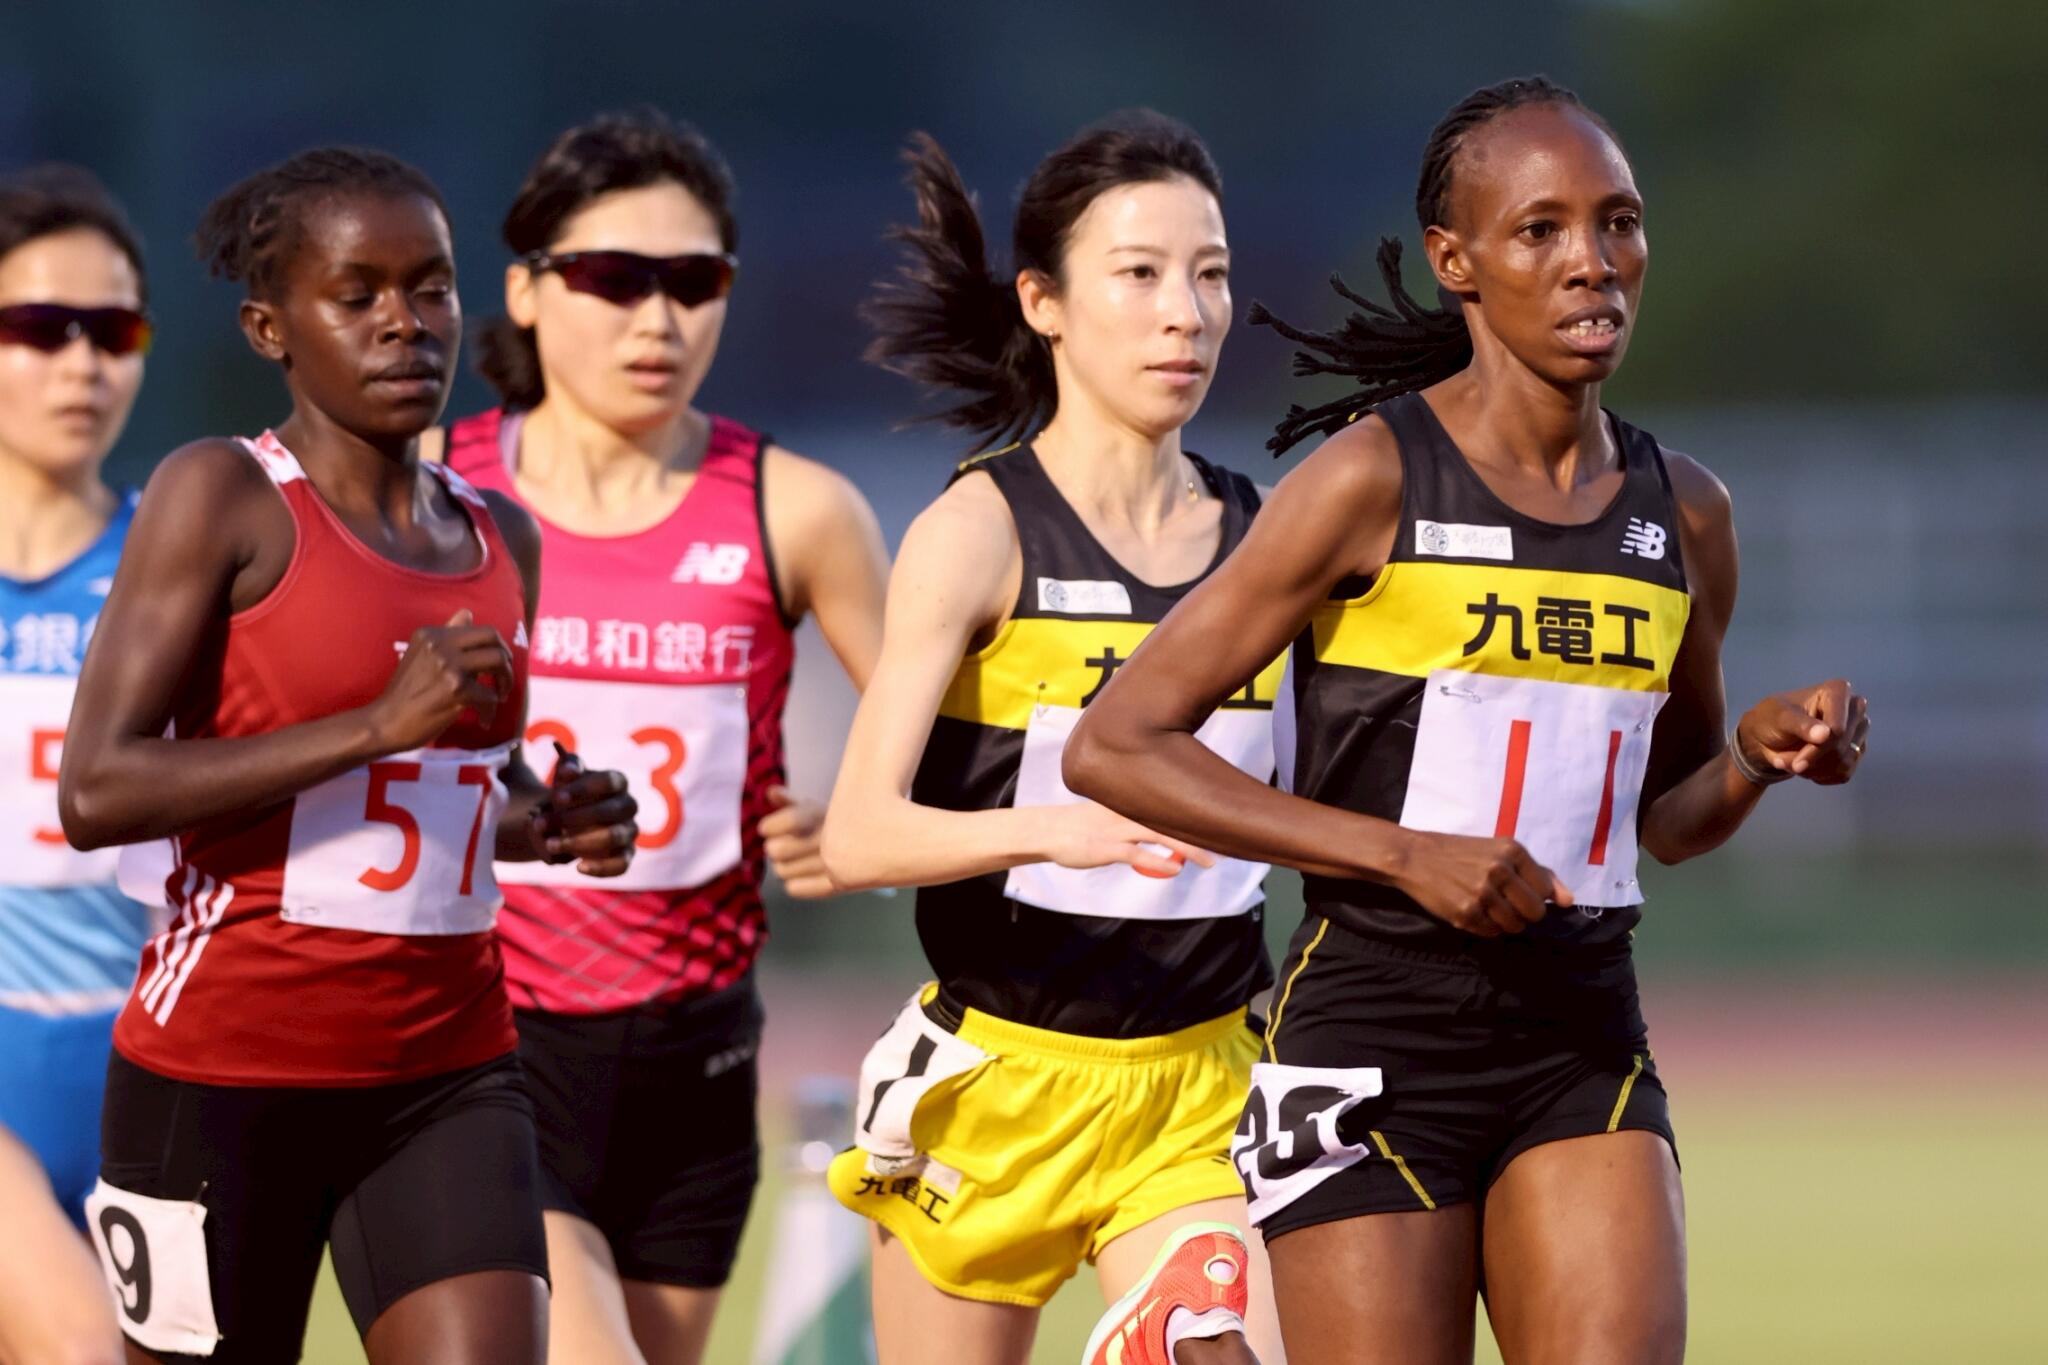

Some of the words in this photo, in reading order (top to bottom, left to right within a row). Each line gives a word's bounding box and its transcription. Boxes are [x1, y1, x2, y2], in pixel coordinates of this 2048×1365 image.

[671, 542, 750, 584] NB
[536, 616, 755, 676] 親和銀行
[1463, 592, 1655, 671] 九電工
[358, 762, 492, 896] 57
[1494, 719, 1622, 865] 11
